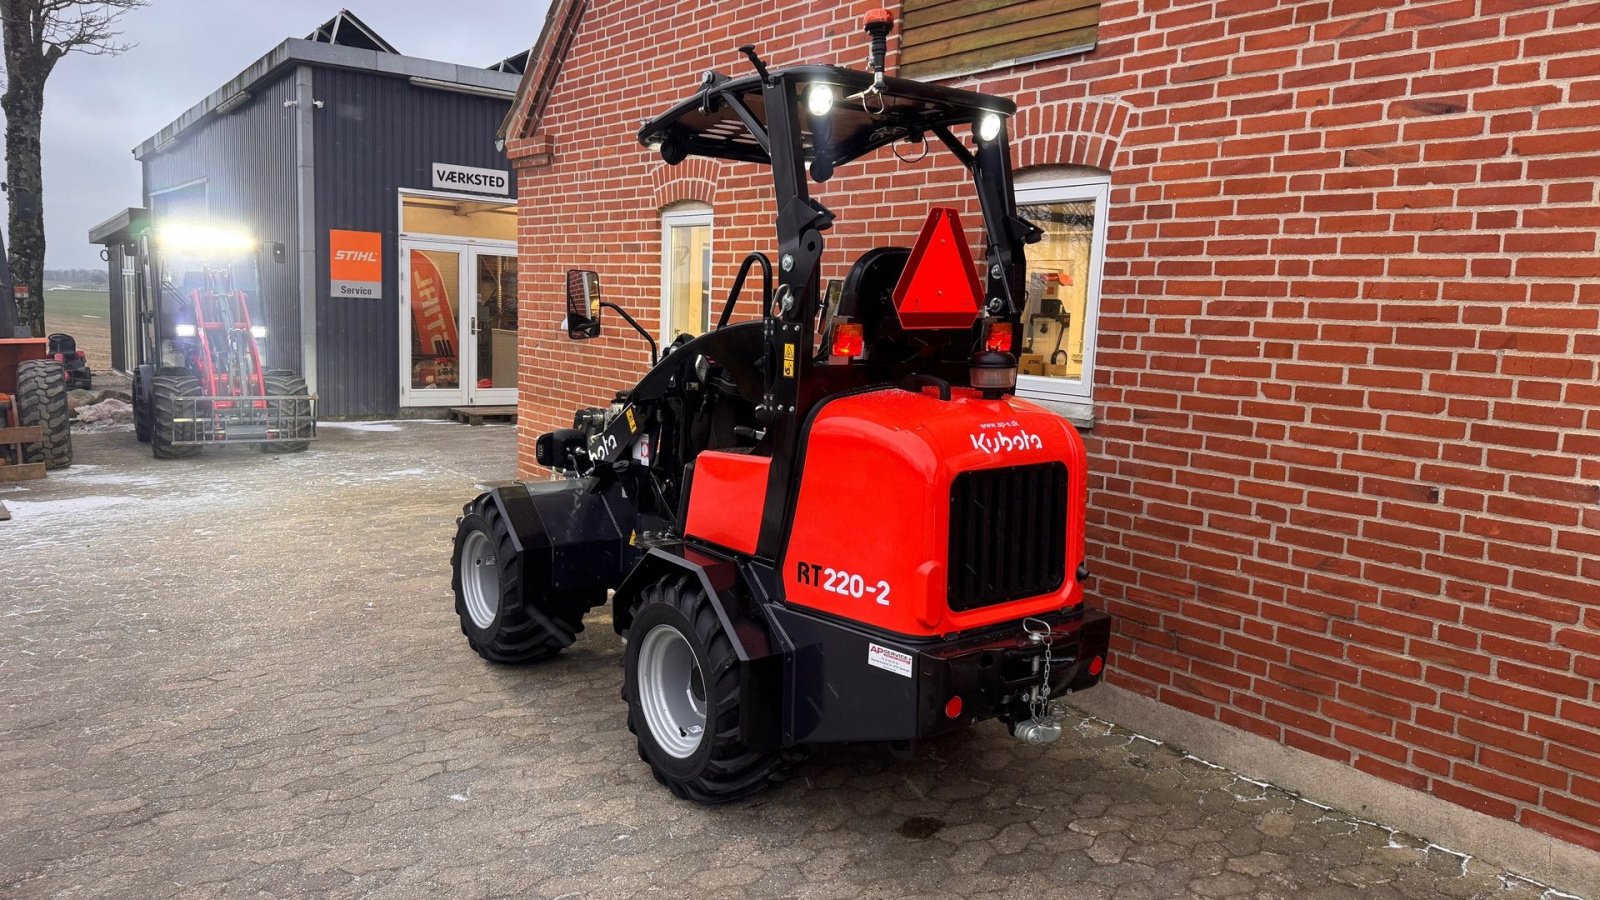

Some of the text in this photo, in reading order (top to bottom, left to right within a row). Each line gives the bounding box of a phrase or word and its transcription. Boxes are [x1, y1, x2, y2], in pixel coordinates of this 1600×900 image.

[436, 169, 505, 188] VÆRKSTED
[334, 250, 377, 262] STIHL
[340, 285, 372, 295] Service
[969, 429, 1043, 454] Kubota
